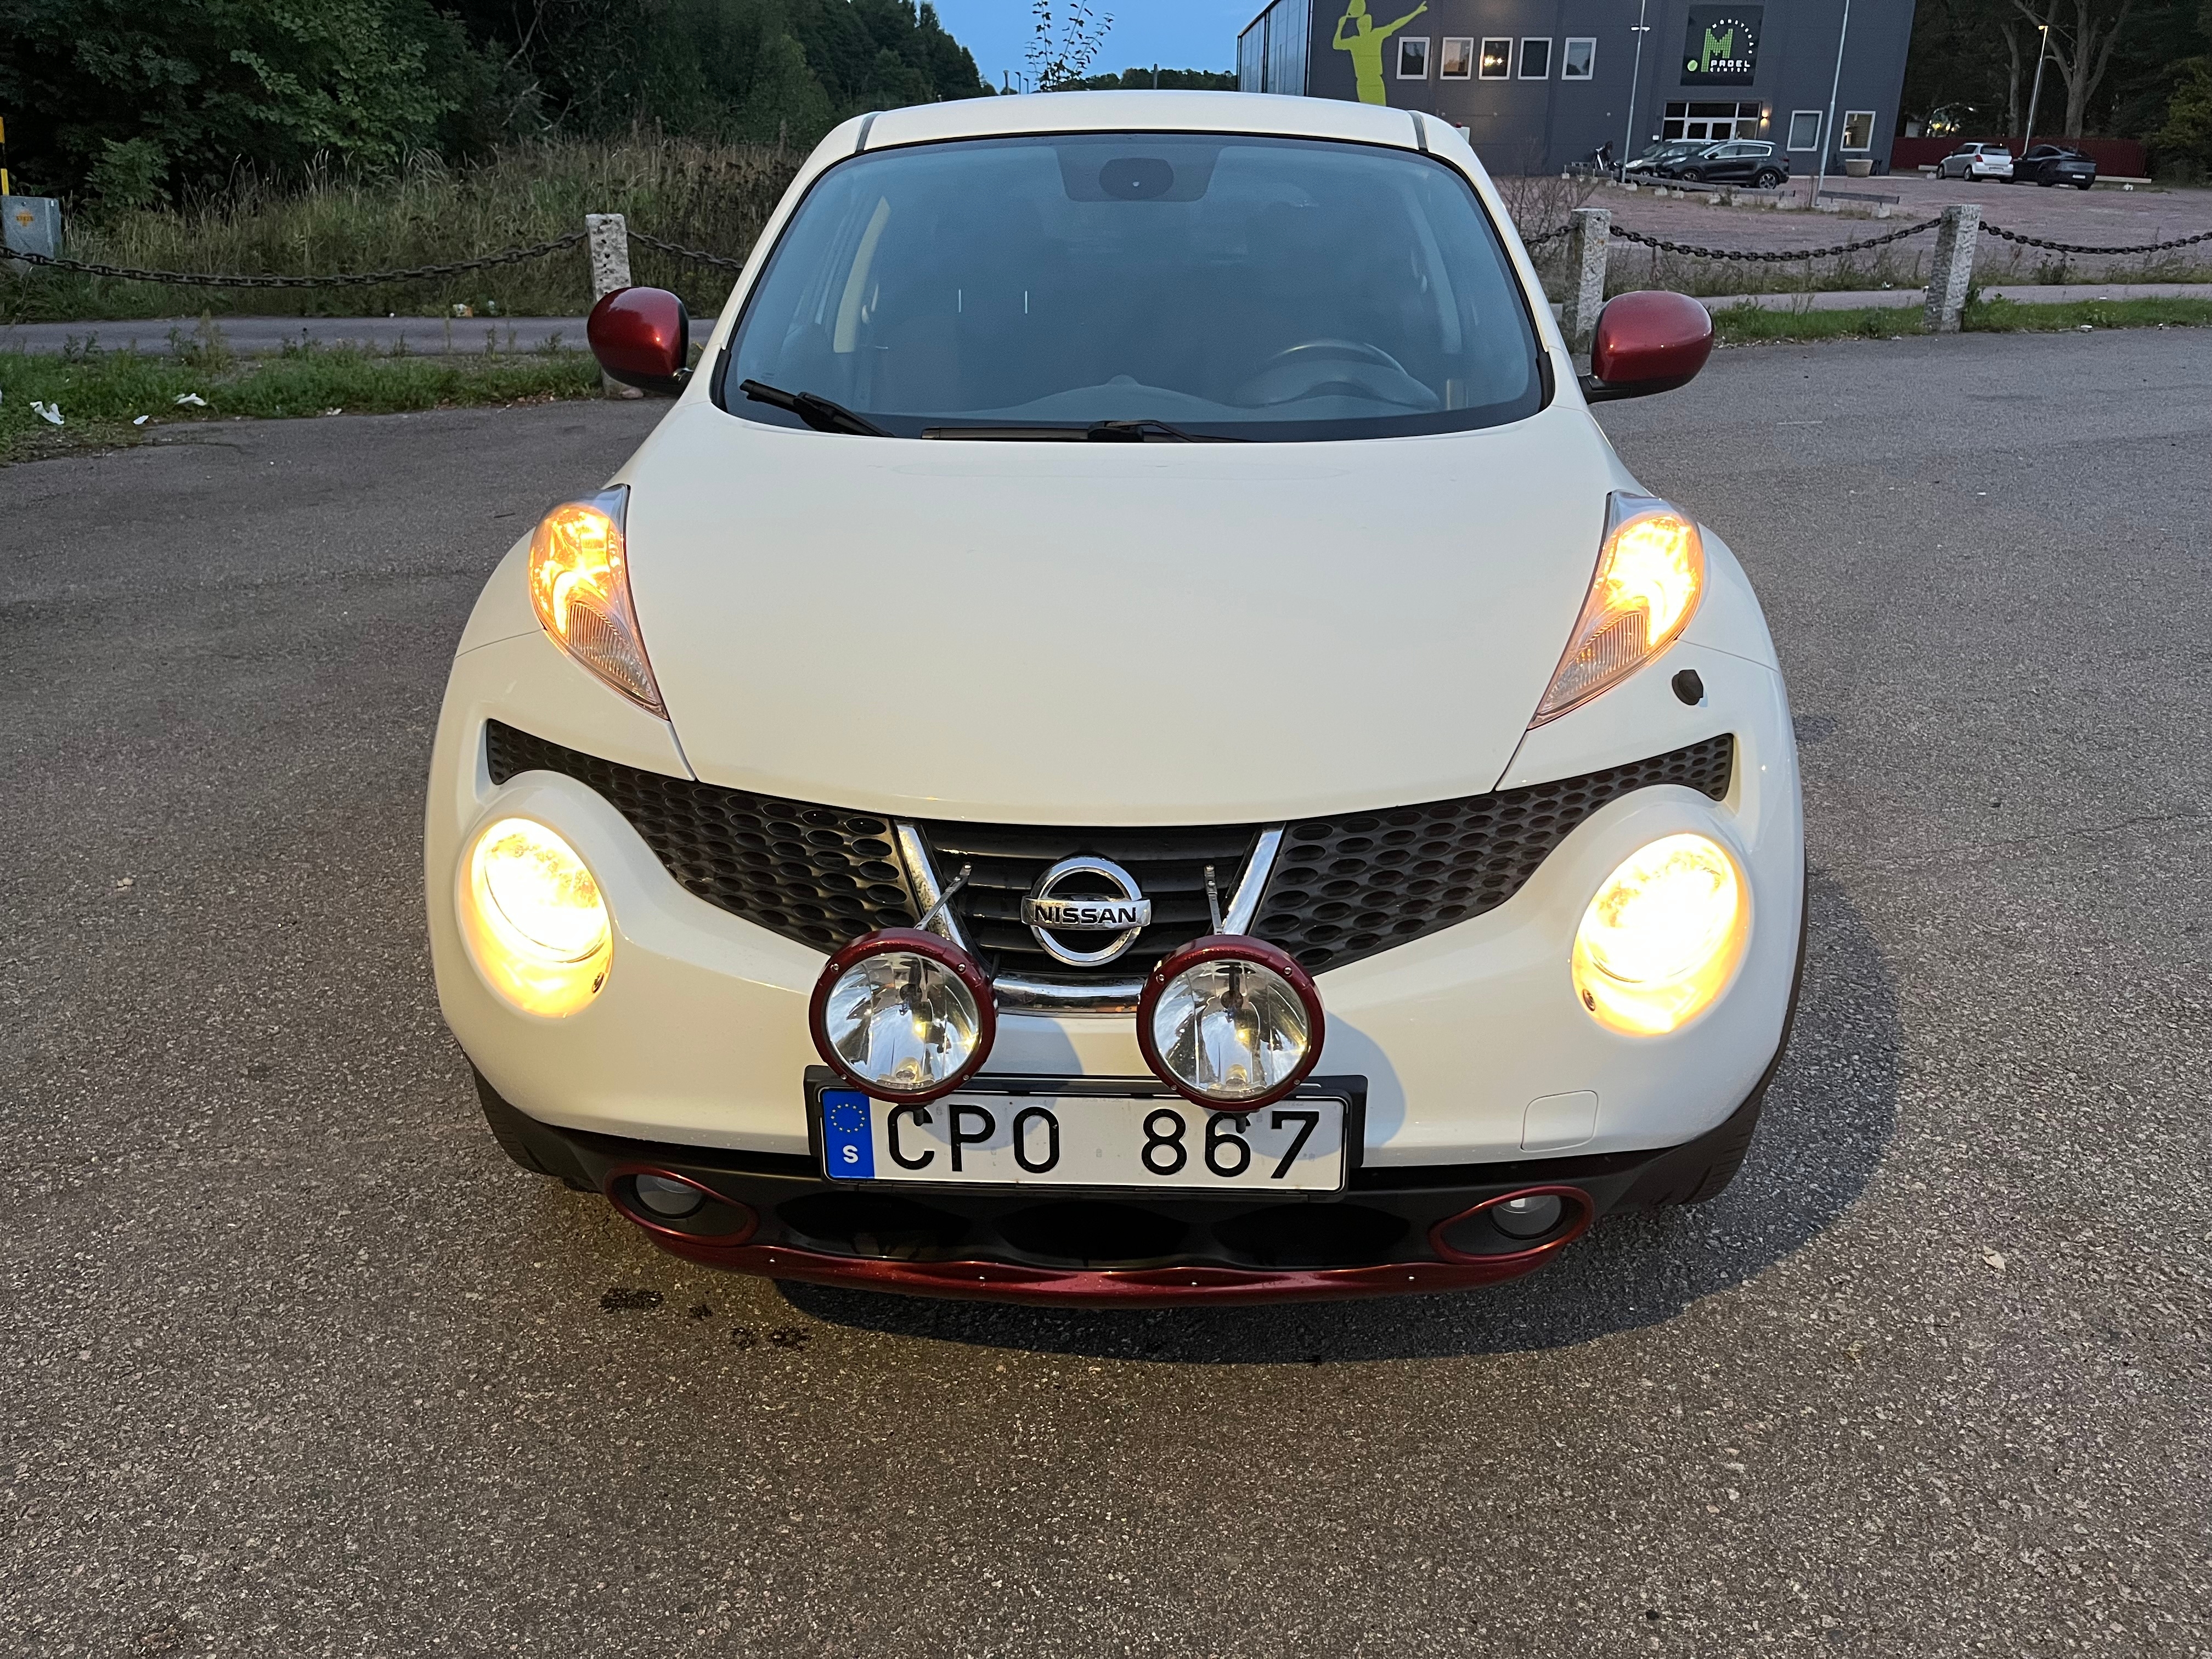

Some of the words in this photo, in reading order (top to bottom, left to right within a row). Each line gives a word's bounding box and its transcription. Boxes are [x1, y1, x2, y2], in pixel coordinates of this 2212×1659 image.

[1710, 59, 1751, 67] PADEL
[1035, 905, 1137, 924] NISSAN
[887, 1104, 1060, 1173] CPO
[1141, 1108, 1320, 1178] 867
[842, 1144, 859, 1164] S
